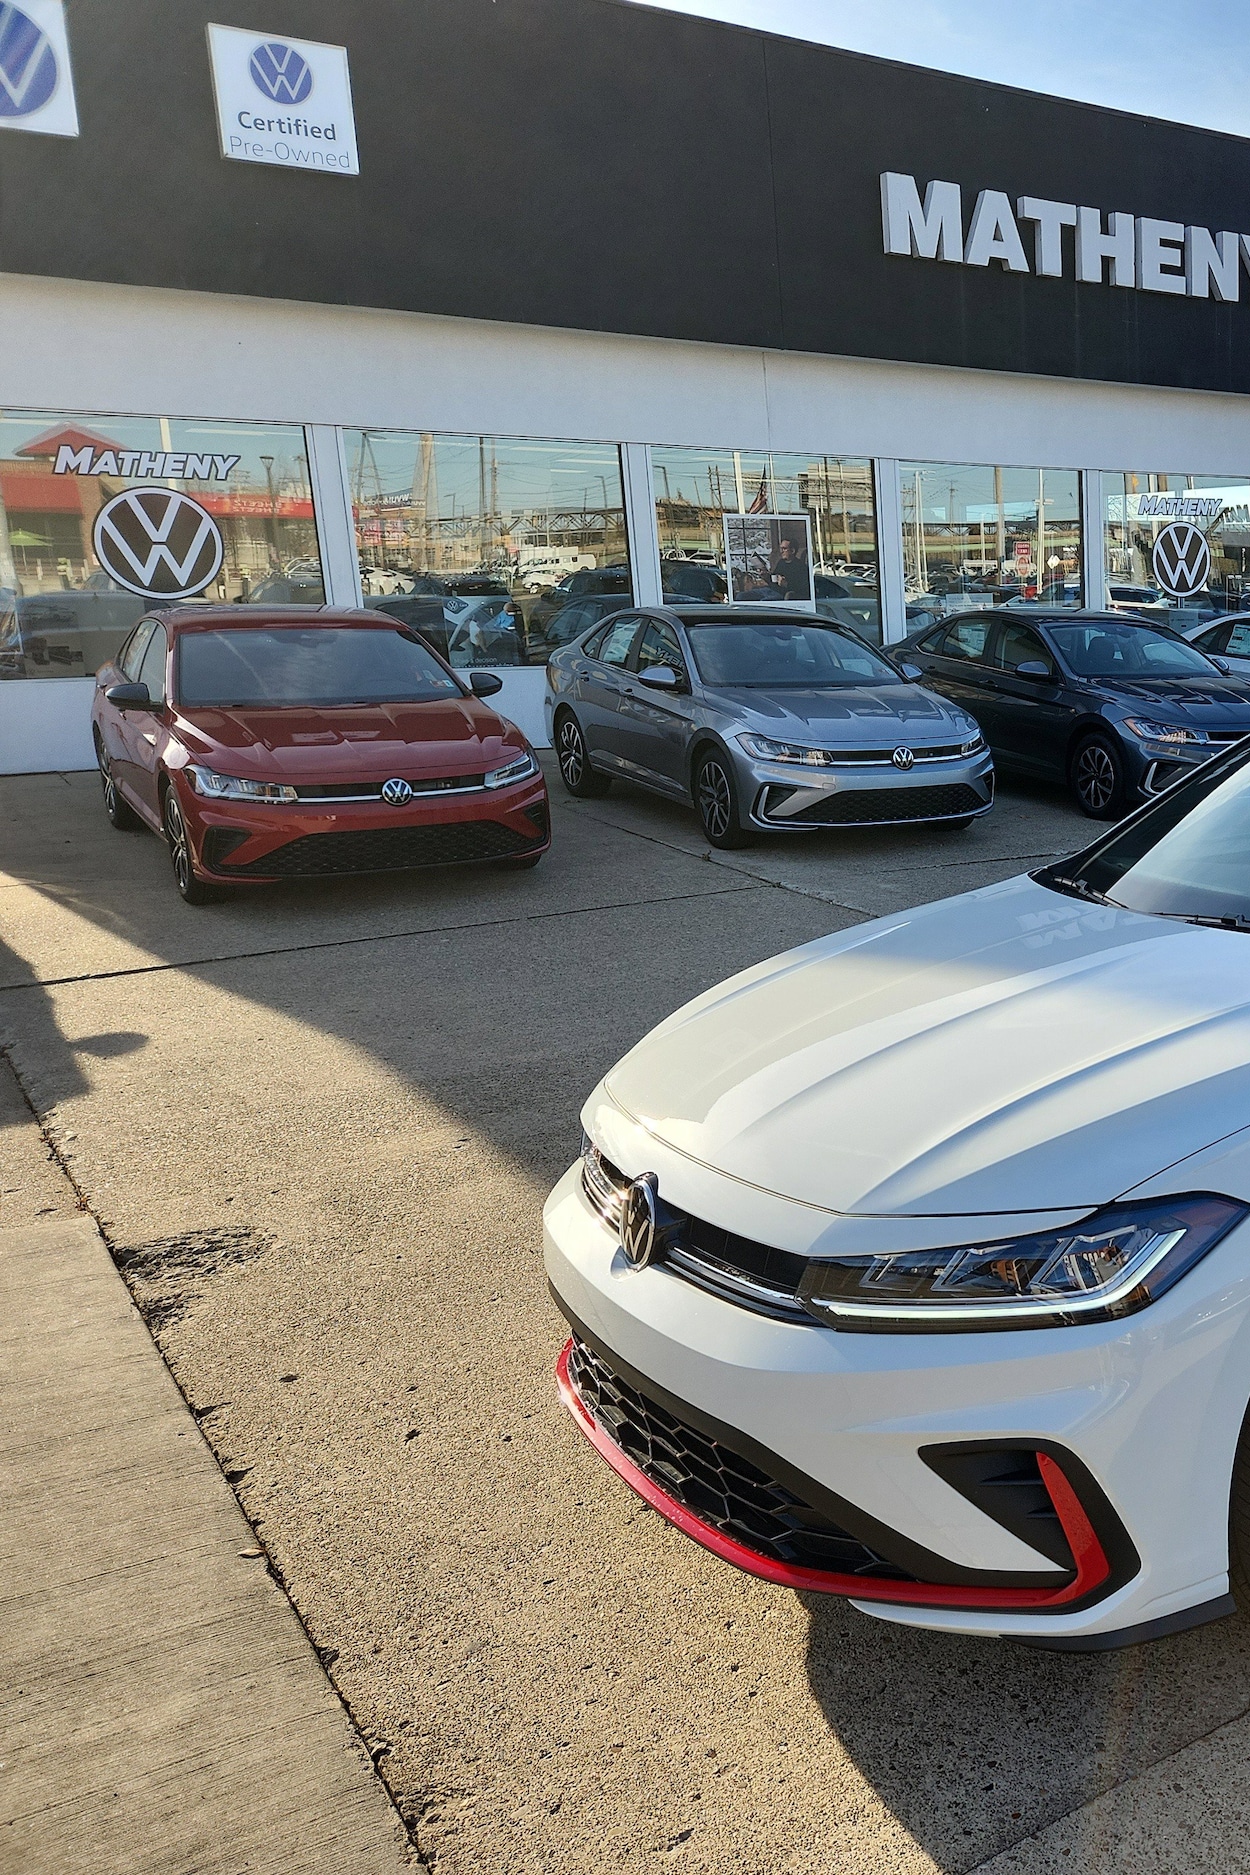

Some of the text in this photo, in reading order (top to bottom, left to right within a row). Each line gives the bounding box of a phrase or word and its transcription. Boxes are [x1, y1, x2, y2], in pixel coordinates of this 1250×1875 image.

[237, 110, 337, 141] Certified
[229, 135, 351, 168] Pre-Owned
[53, 444, 242, 481] MATHENY
[1138, 495, 1223, 516] MATHENY
